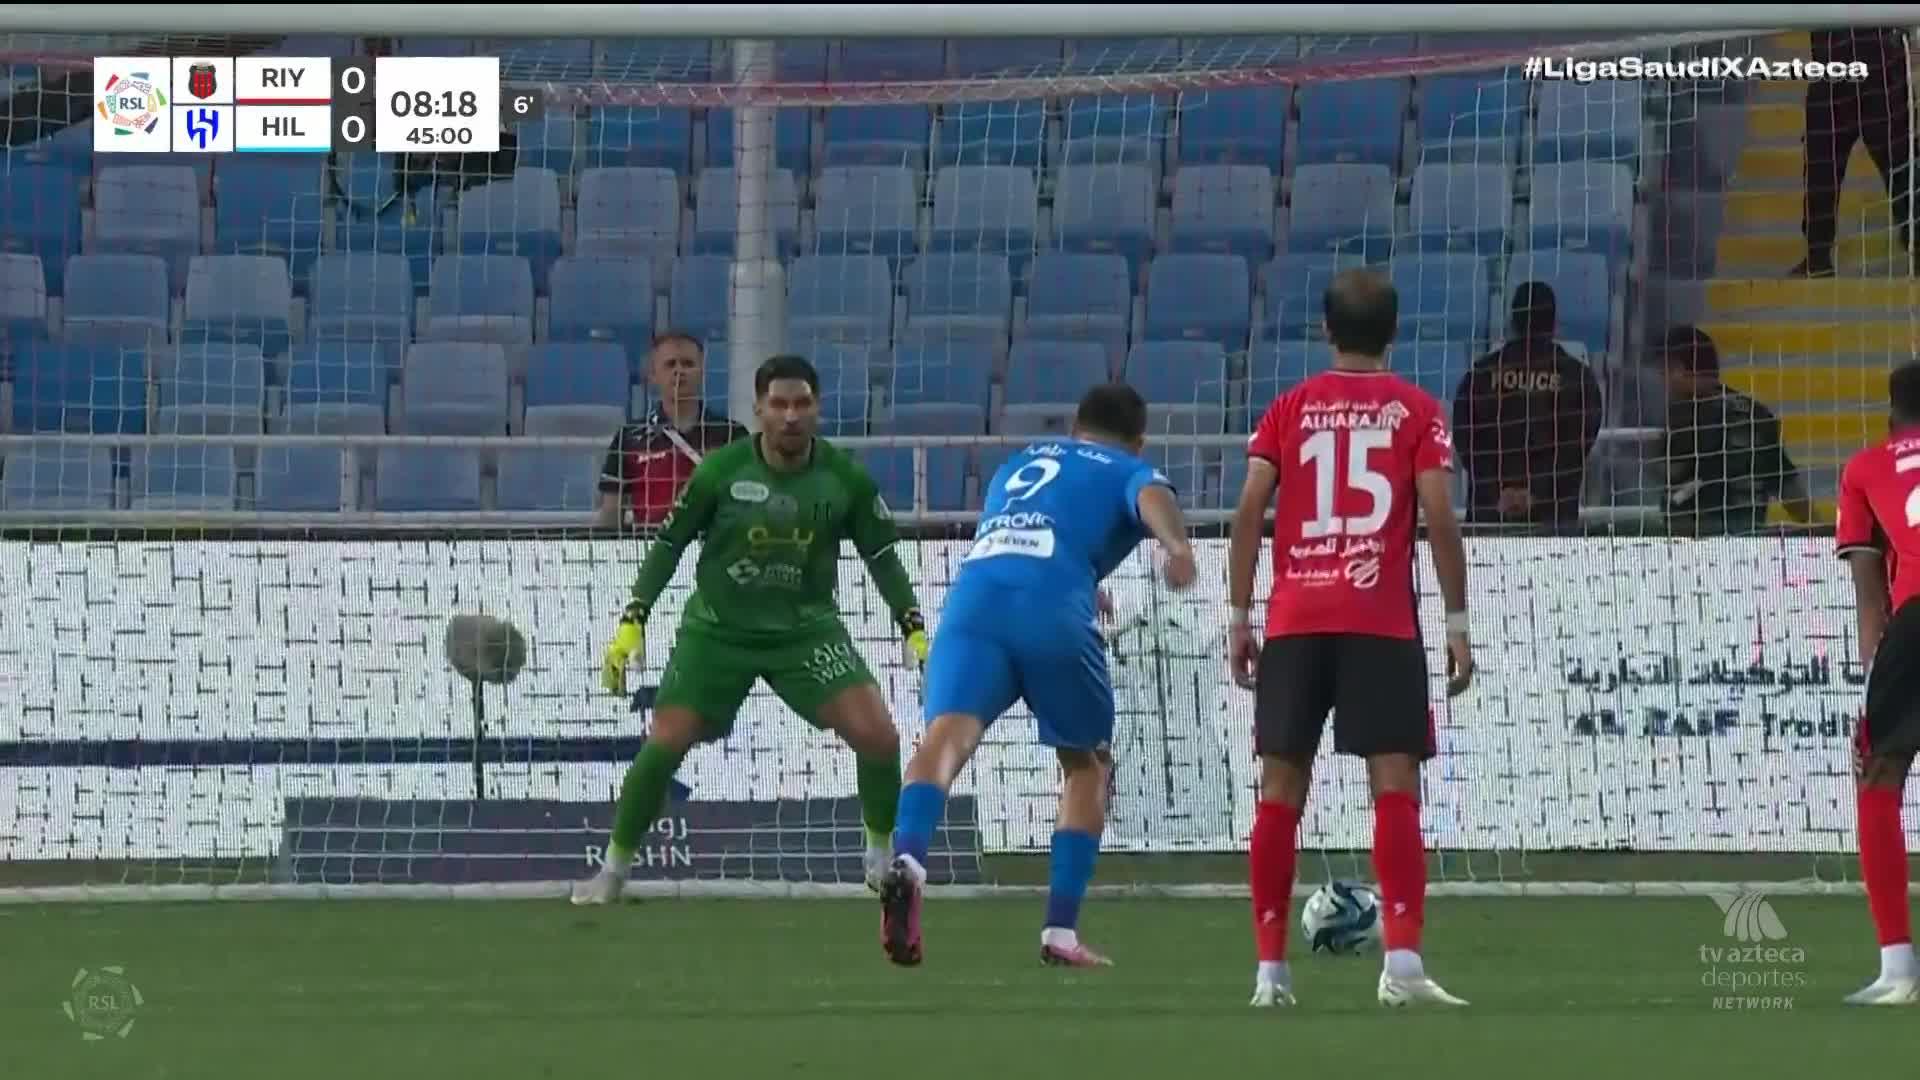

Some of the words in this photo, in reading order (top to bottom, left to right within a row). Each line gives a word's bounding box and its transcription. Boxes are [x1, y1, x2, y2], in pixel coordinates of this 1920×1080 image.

[1491, 370, 1561, 392] POLICE
[1001, 457, 1061, 513] 9
[1300, 430, 1393, 539] 15
